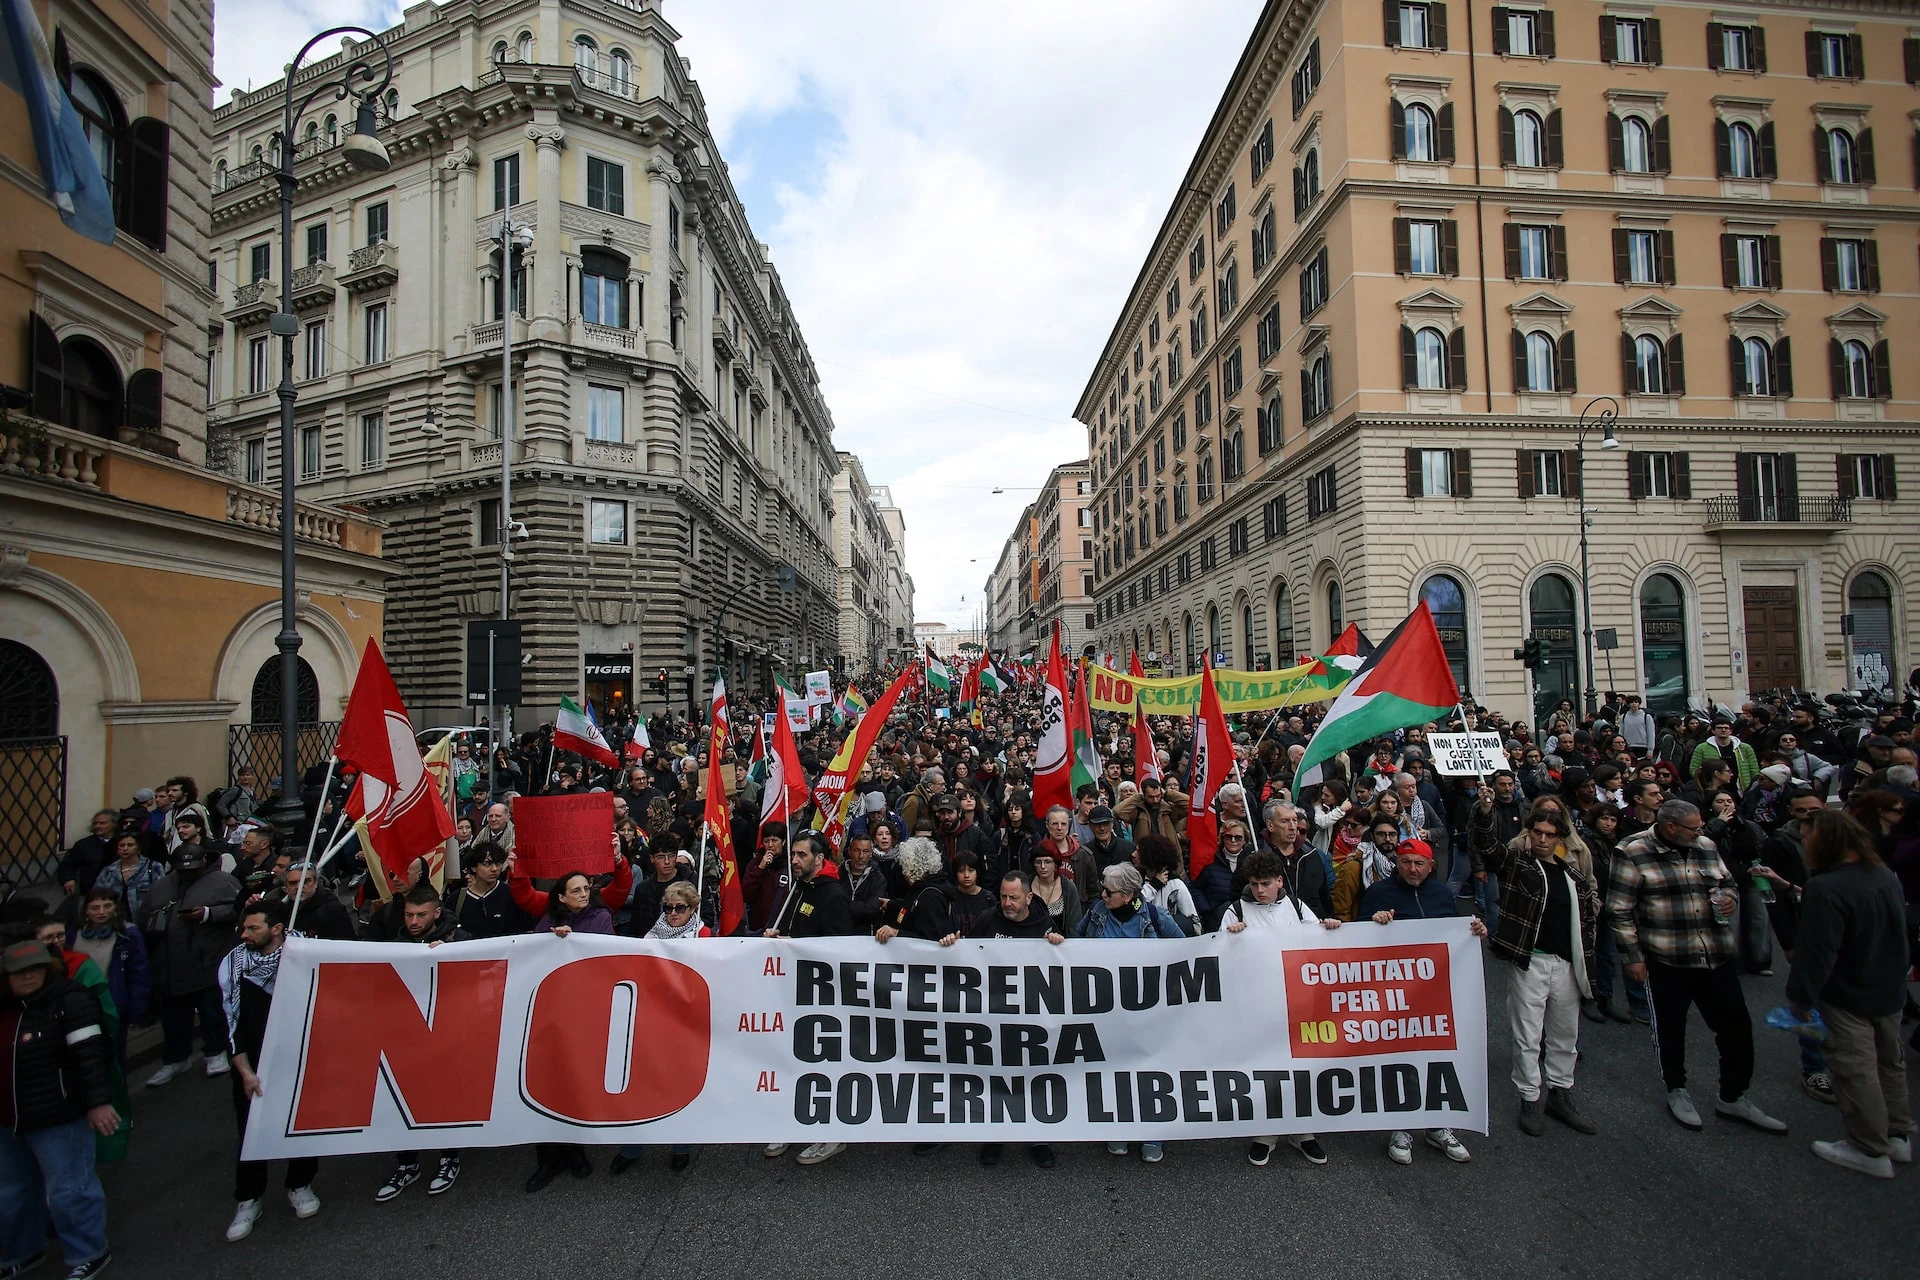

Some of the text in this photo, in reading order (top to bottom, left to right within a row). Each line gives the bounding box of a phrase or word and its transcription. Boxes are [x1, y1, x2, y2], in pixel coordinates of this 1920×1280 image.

[585, 665, 632, 674] TIGER
[1095, 673, 1133, 705] NO
[1433, 737, 1500, 749] NON ESSTONO
[763, 956, 1222, 1015] AL REFERENDUM
[1300, 957, 1436, 985] COMITATO
[1331, 988, 1410, 1013] PER IL
[738, 1012, 1106, 1067] ALLA GUERRA
[1300, 1014, 1451, 1044] NO SOCIALE
[285, 954, 712, 1138] NO
[756, 1061, 1469, 1125] AL GOVERNO LIBERTICIDA
